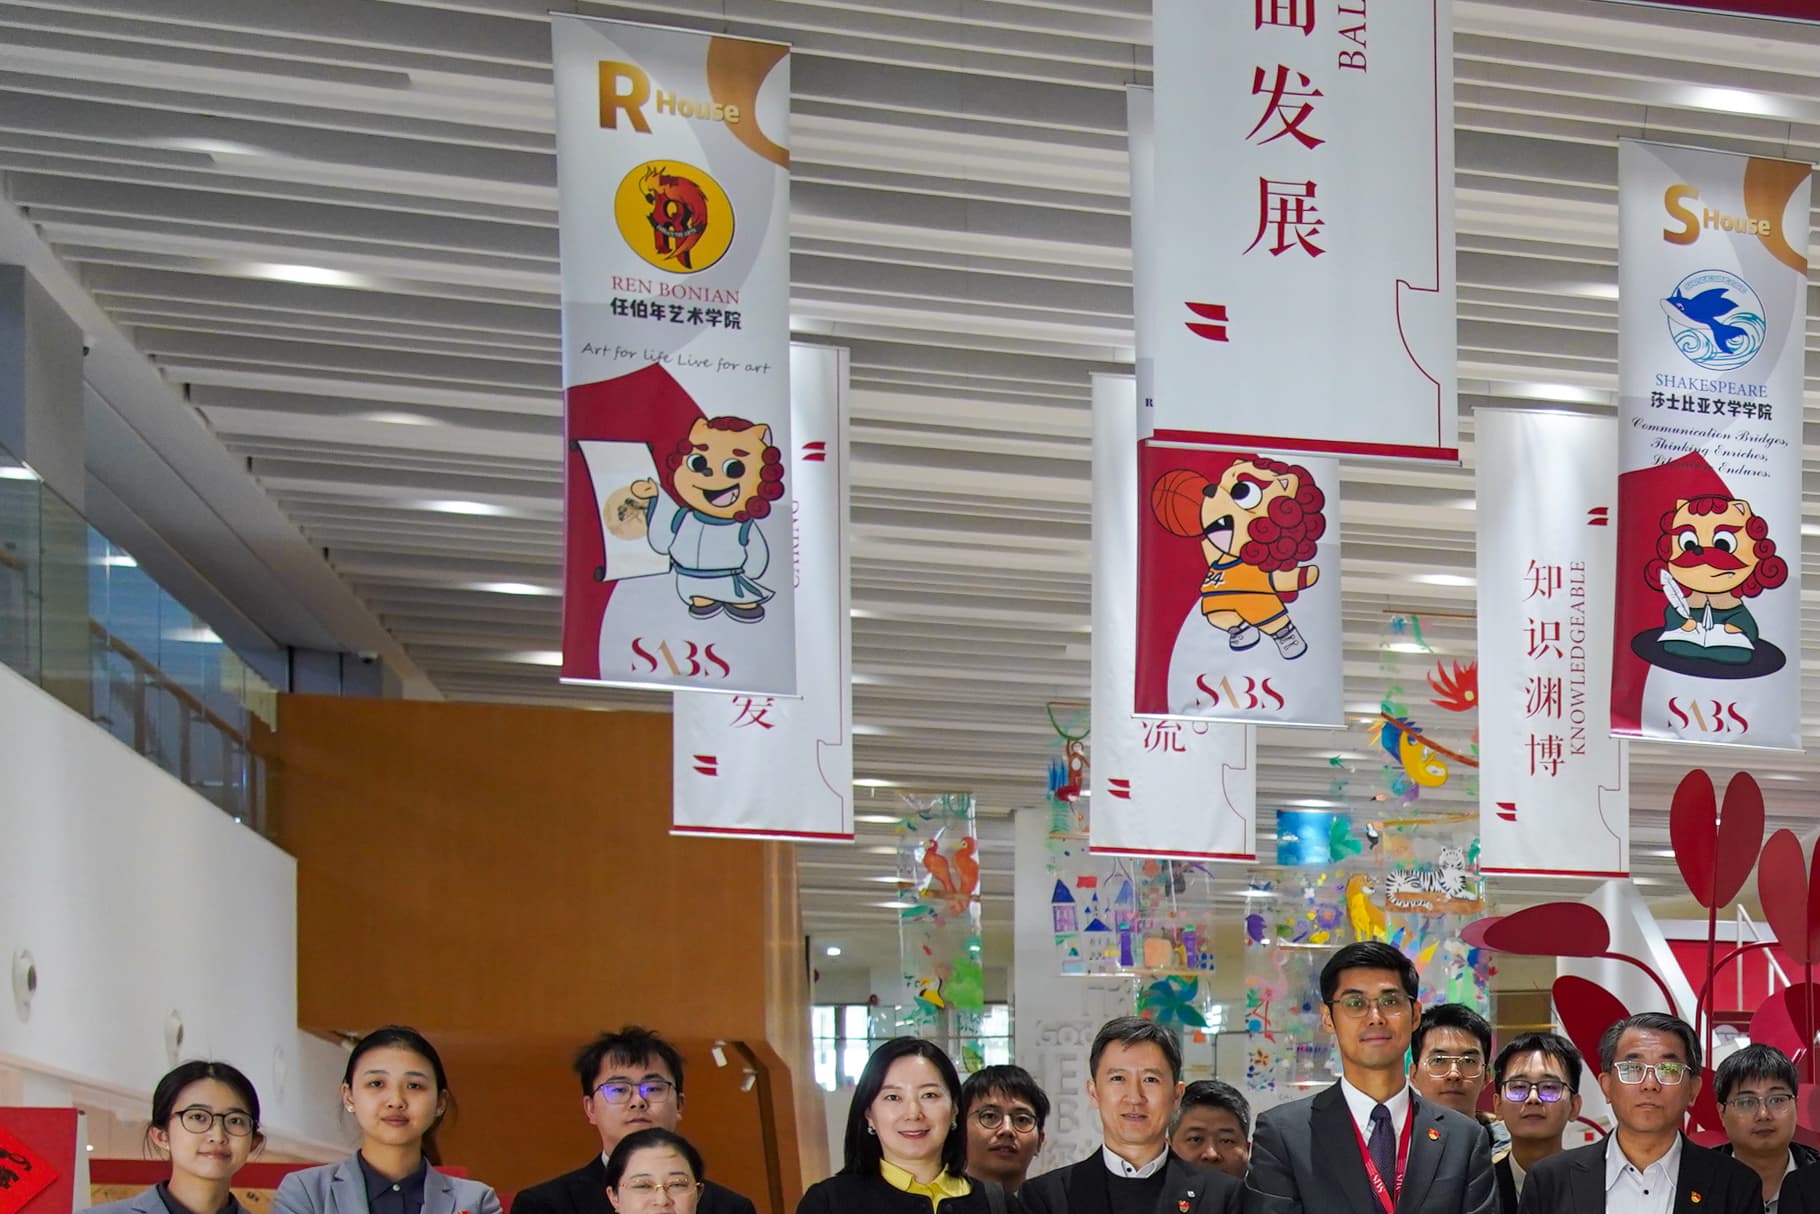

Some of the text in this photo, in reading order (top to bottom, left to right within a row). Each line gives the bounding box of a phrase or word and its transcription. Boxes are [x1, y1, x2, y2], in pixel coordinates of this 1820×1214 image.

[599, 60, 742, 134] R House
[1663, 183, 1772, 245] S House
[611, 275, 740, 304] REN BONIAN
[610, 296, 742, 330] 任伯年艺术学院
[581, 341, 771, 374] Art for life Live for art
[1655, 373, 1768, 398] SHAKESPEARE
[1650, 390, 1773, 421] 莎士比亚文学学院
[1631, 416, 1731, 441] Communication
[631, 636, 731, 679] SABS
[1522, 558, 1566, 778] 知识渊博
[1569, 560, 1587, 756] KNOWLEDGEABLE
[1196, 673, 1285, 711] SABS
[1667, 696, 1749, 735] SABS
